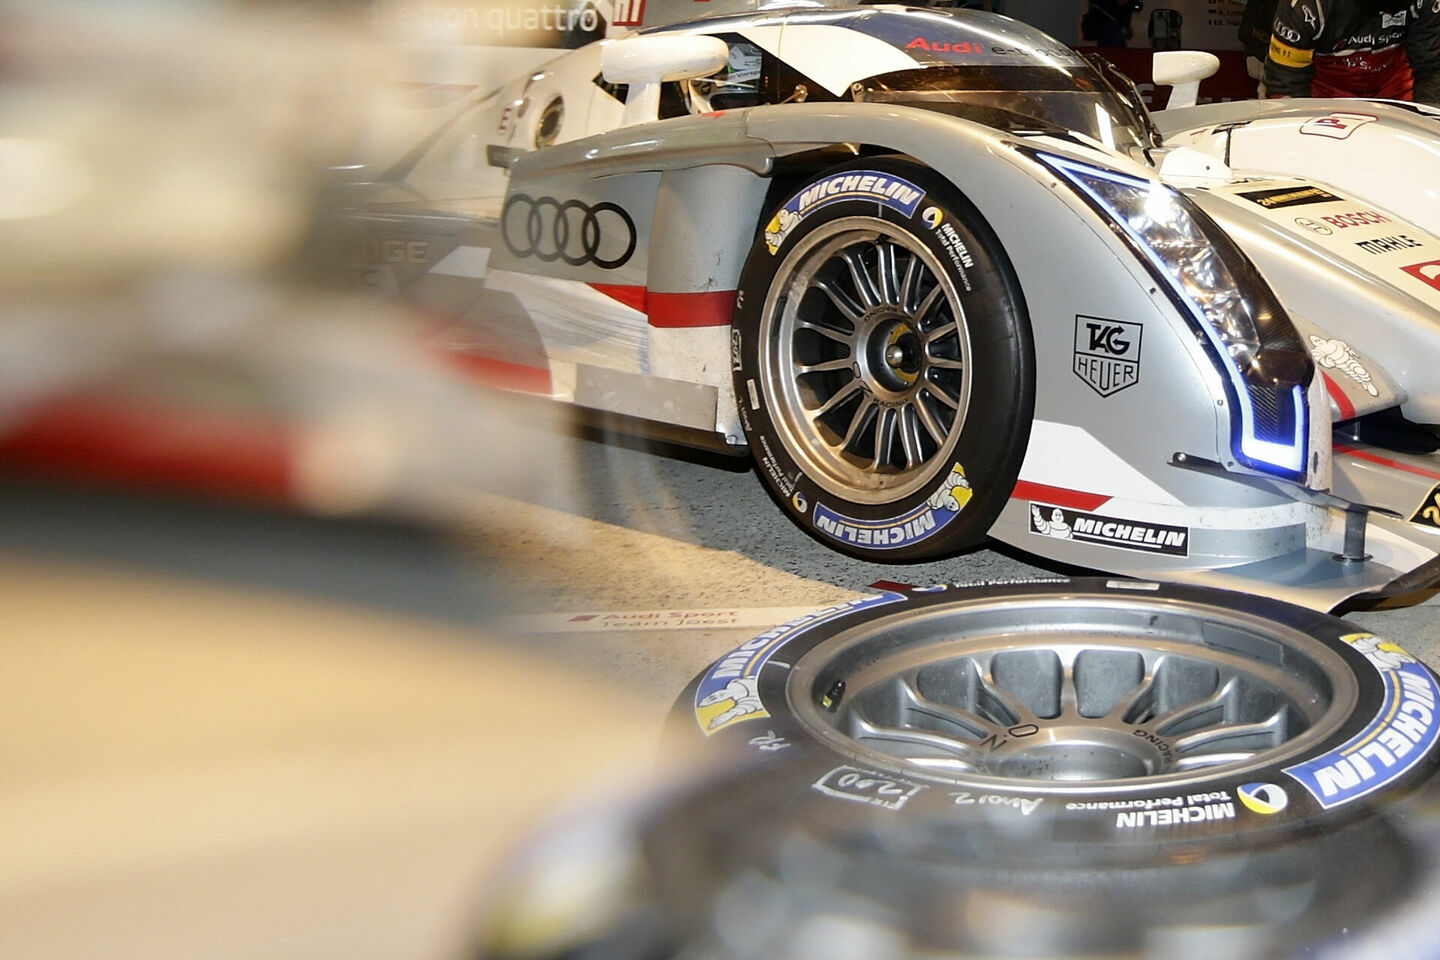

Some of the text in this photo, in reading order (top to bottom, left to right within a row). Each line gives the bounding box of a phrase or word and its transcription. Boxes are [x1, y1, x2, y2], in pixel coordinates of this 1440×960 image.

[488, 3, 598, 34] quattro
[906, 37, 983, 54] Audi
[1348, 34, 1375, 46] Audi
[799, 175, 919, 209] MICHELIN
[1322, 211, 1392, 229] BOSCH
[940, 223, 974, 269] MICHELIN
[1355, 235, 1424, 255] MAHLE
[1086, 323, 1130, 355] TAG
[1079, 357, 1134, 391] HEUER
[816, 510, 936, 545] MICHELIN
[1073, 518, 1185, 547] MICHELIN
[601, 620, 668, 628] Team
[668, 611, 738, 619] Sport
[1313, 670, 1435, 797] MICHELIN
[1065, 790, 1232, 810] Total Performance
[1116, 803, 1235, 828] MICHELIN
